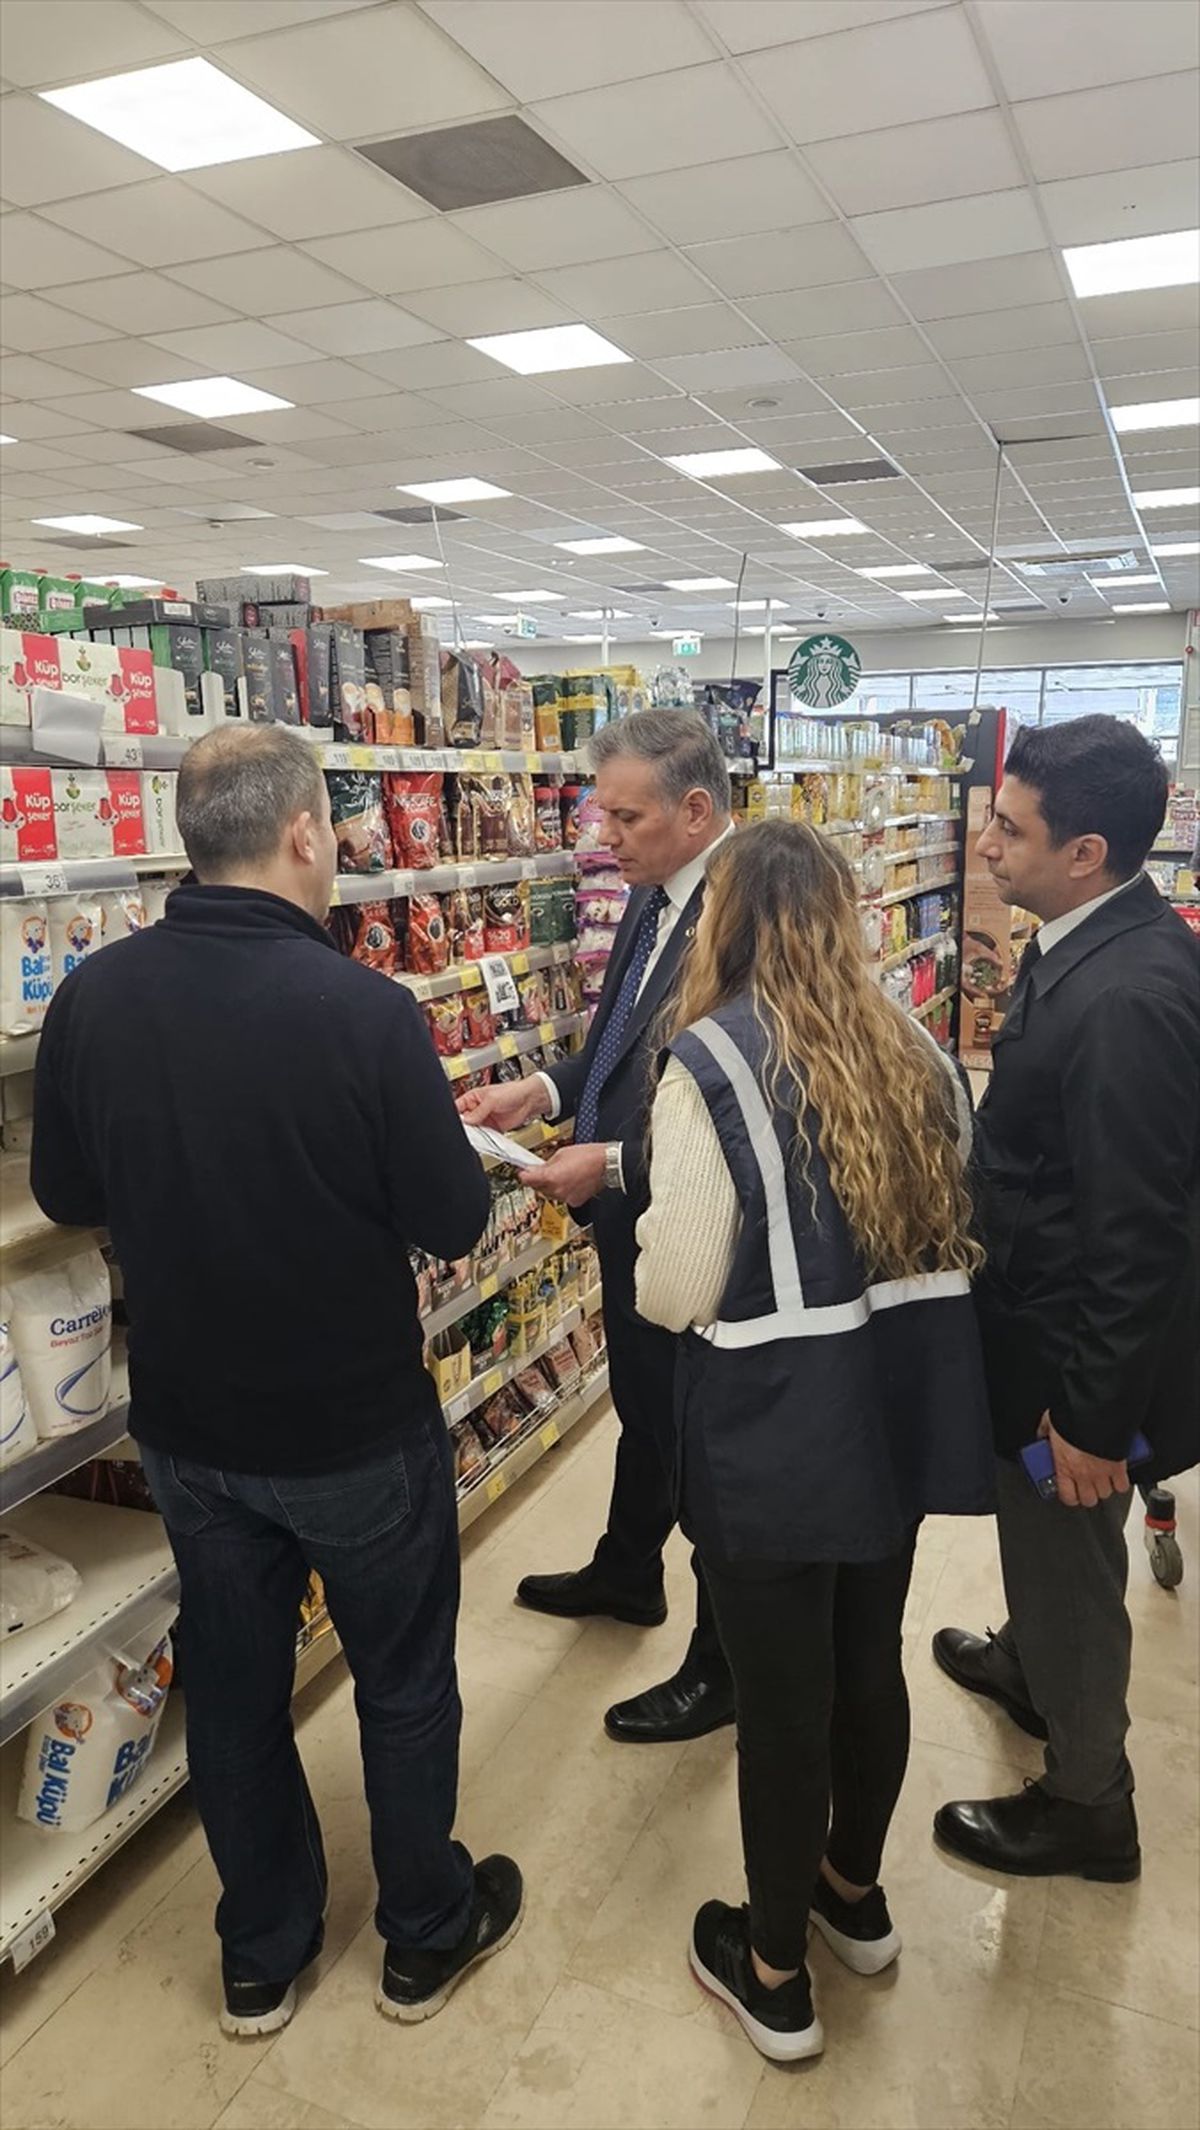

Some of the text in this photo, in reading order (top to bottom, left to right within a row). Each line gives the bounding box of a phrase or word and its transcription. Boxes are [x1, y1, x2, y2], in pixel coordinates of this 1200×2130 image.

[35, 660, 59, 677] Küp
[130, 671, 152, 688] Küp
[25, 792, 51, 810] Küp
[118, 791, 140, 808] Küp
[47, 1740, 76, 1774] Bal
[36, 1773, 69, 1826] Küpü
[29, 1924, 49, 1949] 159
